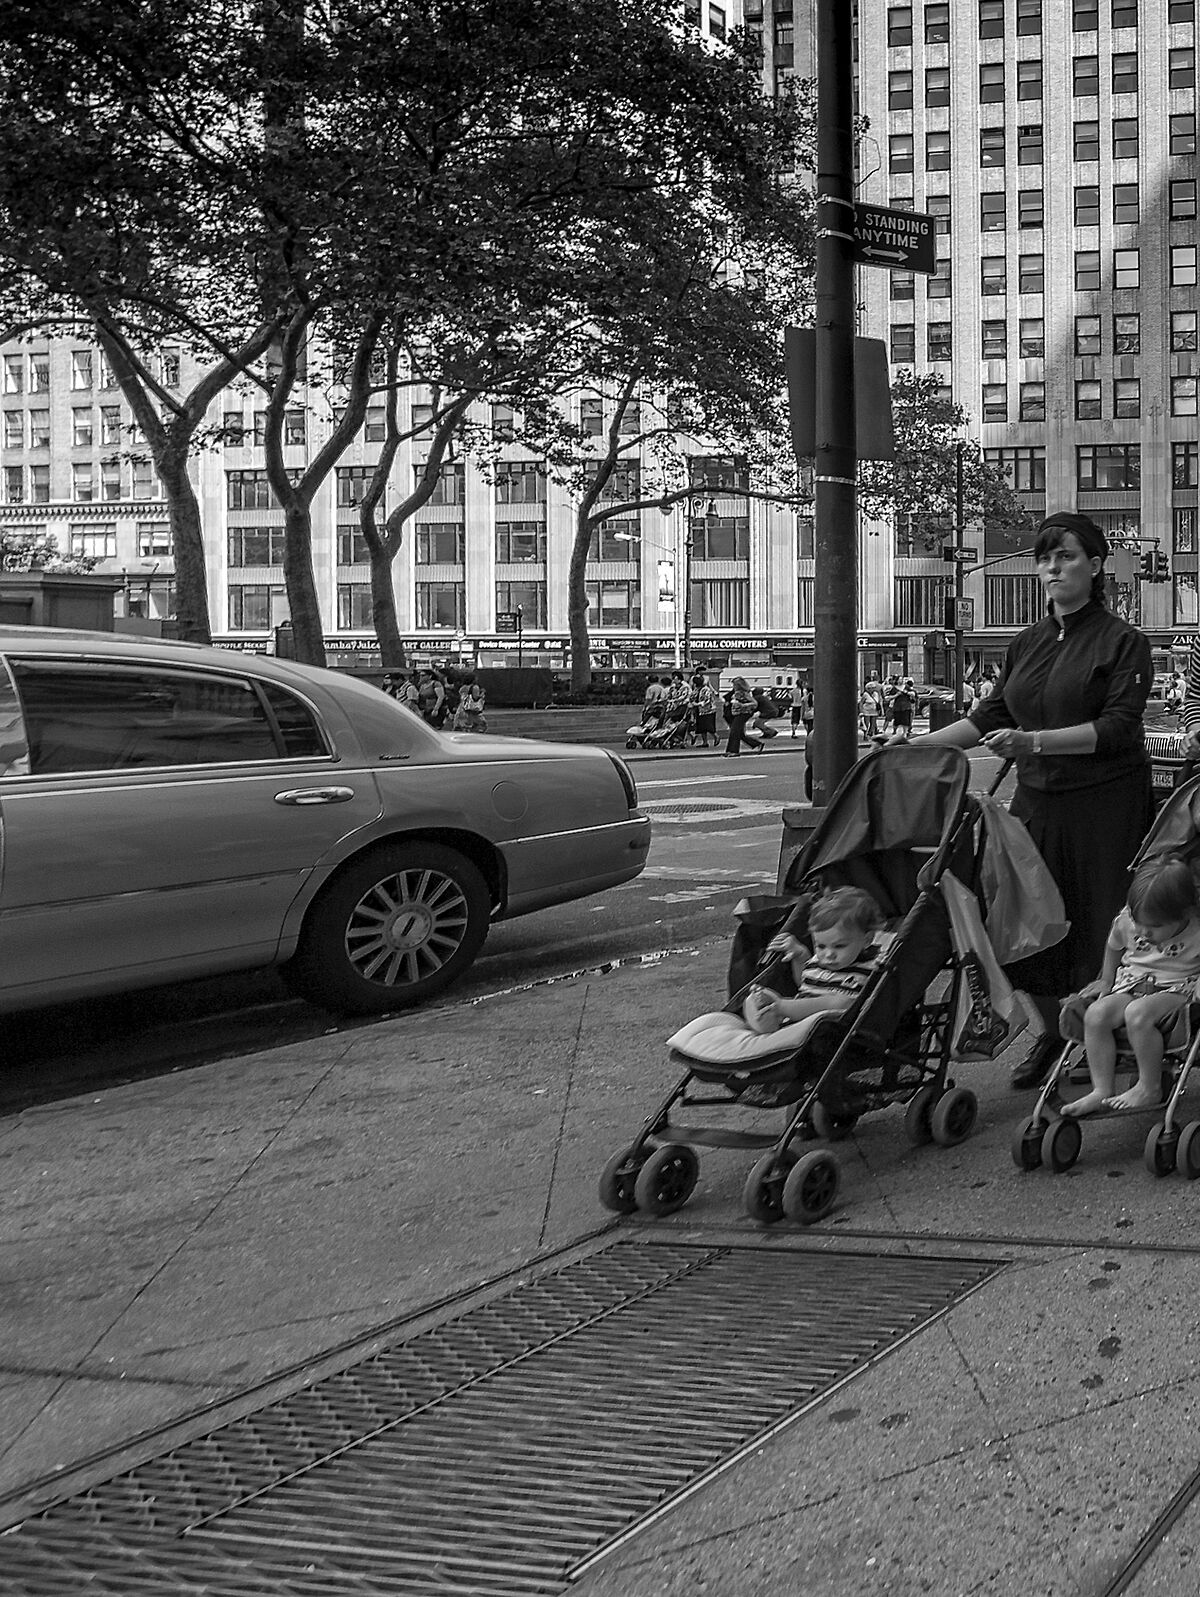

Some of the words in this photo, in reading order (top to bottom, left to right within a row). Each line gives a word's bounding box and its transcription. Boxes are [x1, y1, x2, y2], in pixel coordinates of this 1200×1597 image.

[865, 213, 929, 236] STANDING
[854, 226, 919, 249] ANYTIME
[1172, 635, 1195, 644] ZAR
[420, 641, 451, 650] GALLER
[656, 640, 686, 649] LAFNC
[719, 640, 768, 649] COMPUTERS
